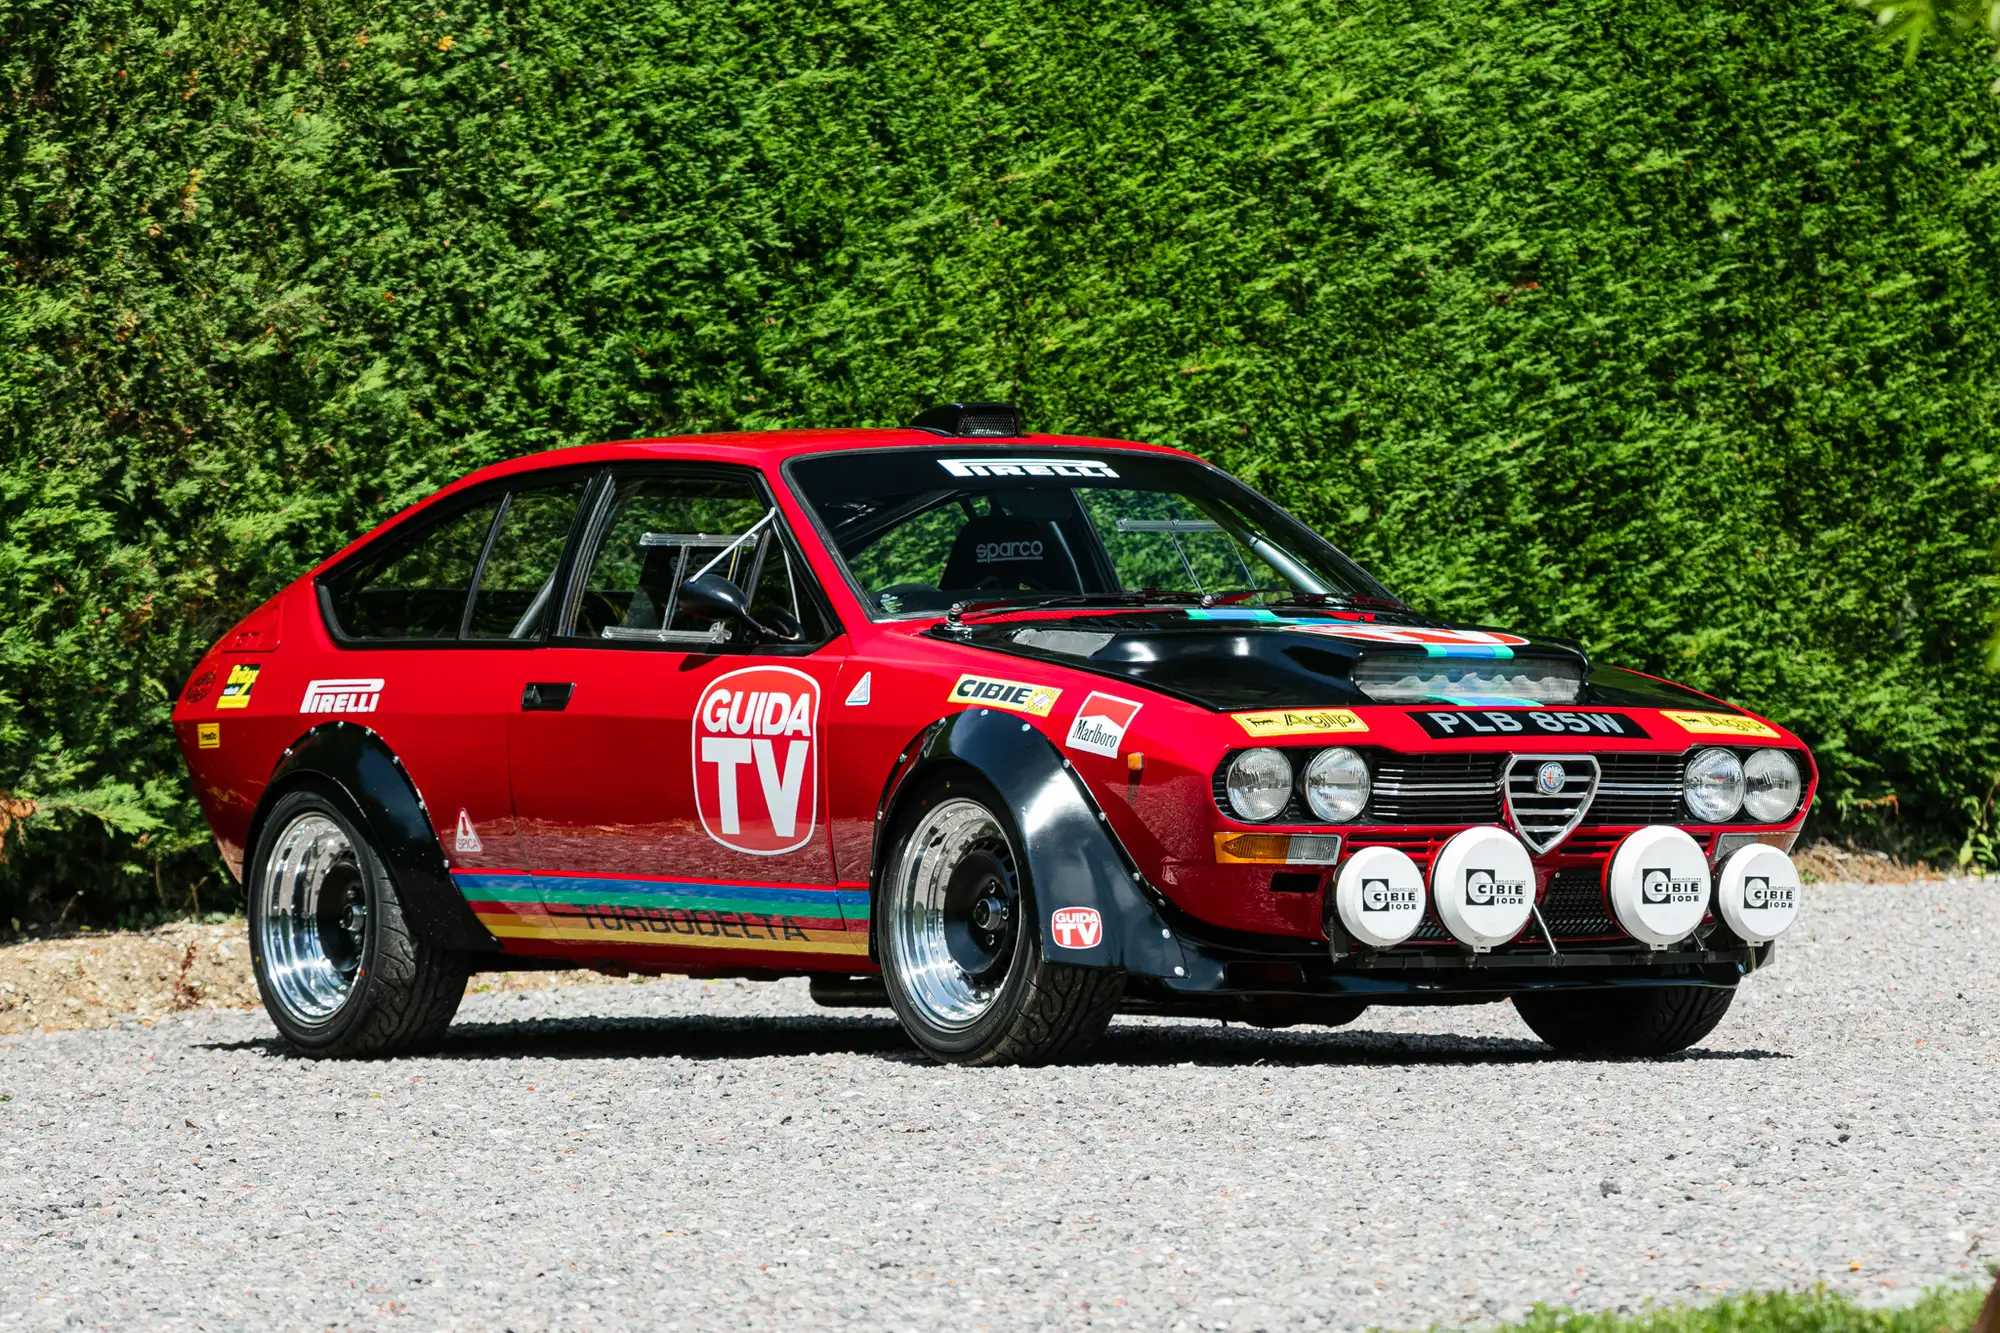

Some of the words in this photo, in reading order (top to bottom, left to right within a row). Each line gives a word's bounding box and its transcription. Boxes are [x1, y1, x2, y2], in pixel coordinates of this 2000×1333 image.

[937, 458, 1120, 478] PIRELLI
[976, 540, 1043, 563] sparco
[300, 678, 385, 713] PIRELLI
[702, 688, 811, 736] GUIDA
[1283, 712, 1356, 729] Agip
[1427, 712, 1523, 734] PLB
[1528, 711, 1625, 734] 85W
[1703, 715, 1766, 732] Agip
[1072, 719, 1118, 748] Marlboro
[702, 737, 809, 838] TV
[571, 904, 811, 942] TURBODELTA
[1055, 912, 1099, 924] GUIDA
[1056, 923, 1099, 945] TV
